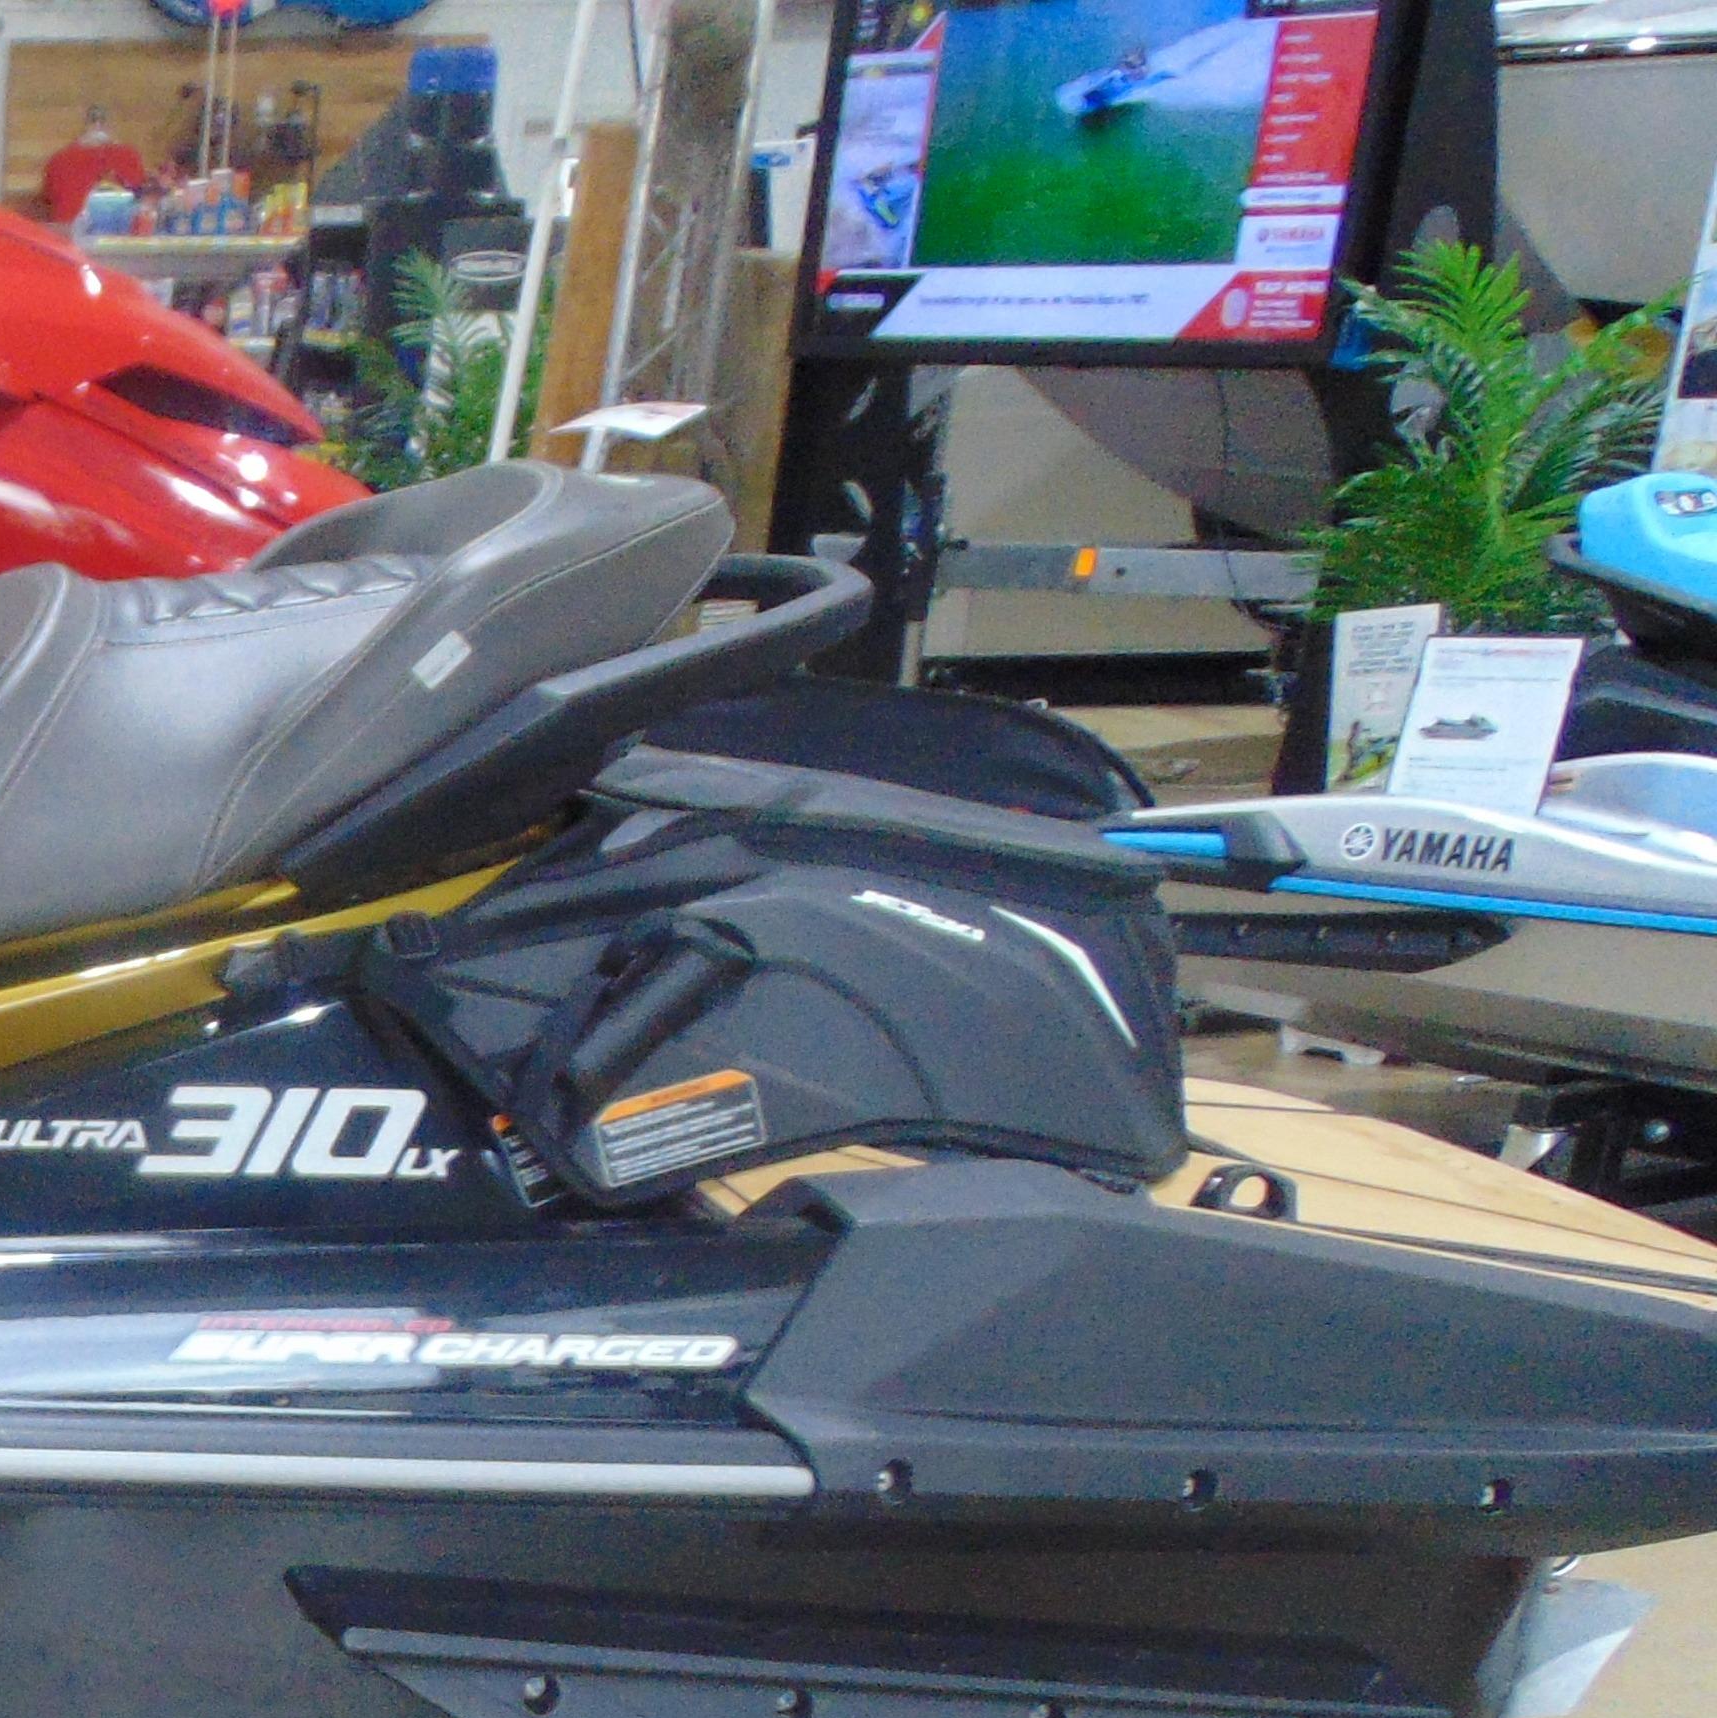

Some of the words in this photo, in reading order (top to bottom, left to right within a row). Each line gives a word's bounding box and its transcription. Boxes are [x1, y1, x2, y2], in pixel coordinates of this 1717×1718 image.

[1379, 826, 1516, 873] YAMAHA
[137, 1085, 428, 1179] 310
[394, 1146, 462, 1180] LX
